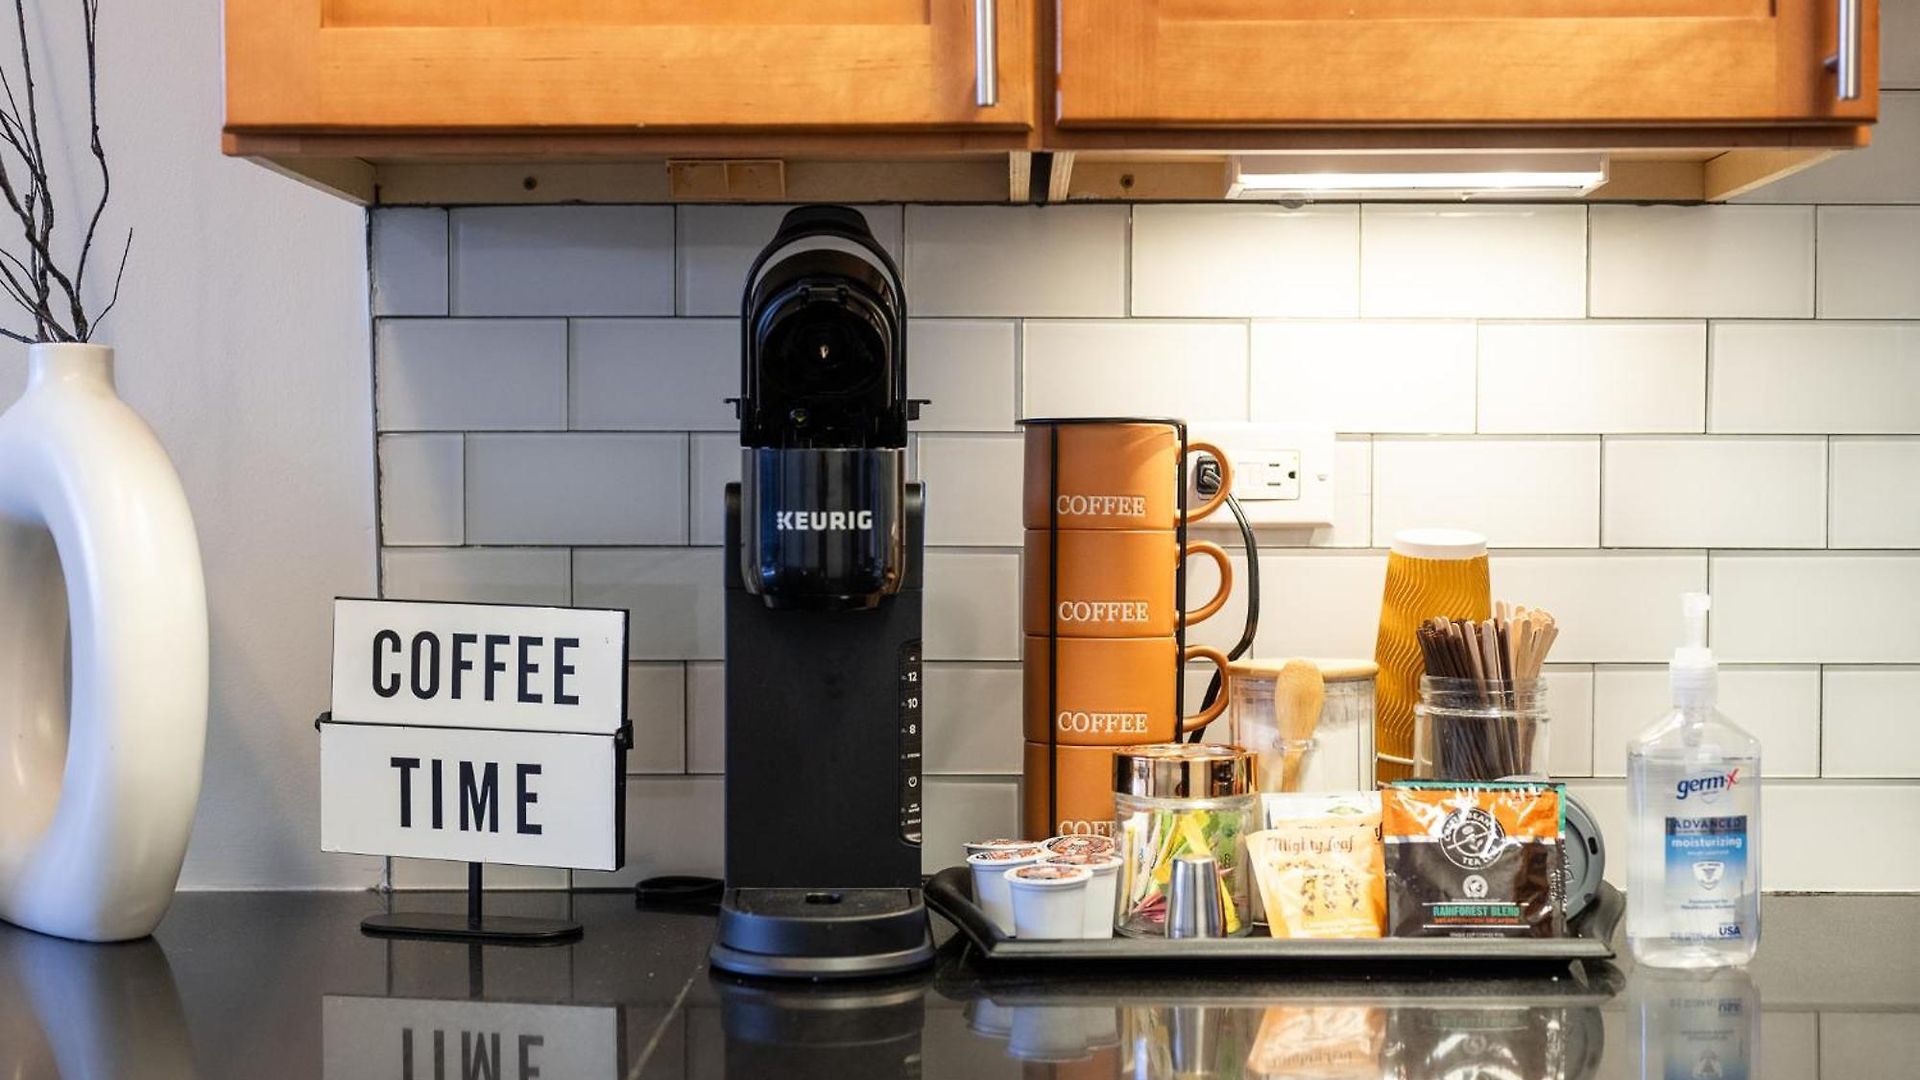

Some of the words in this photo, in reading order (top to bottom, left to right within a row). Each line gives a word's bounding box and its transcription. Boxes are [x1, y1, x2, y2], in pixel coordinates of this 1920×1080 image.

[1056, 494, 1146, 516] COFFEE
[776, 510, 873, 531] KEURIG
[1058, 601, 1149, 622] COFFEE
[372, 629, 580, 705] COFFEE
[907, 671, 918, 682] 12
[907, 697, 918, 709] 10
[909, 724, 916, 734] 8
[1058, 711, 1148, 733] COFFEE
[390, 757, 543, 835] TIME
[1671, 837, 1742, 849] moisturizing
[1719, 926, 1741, 936] USA
